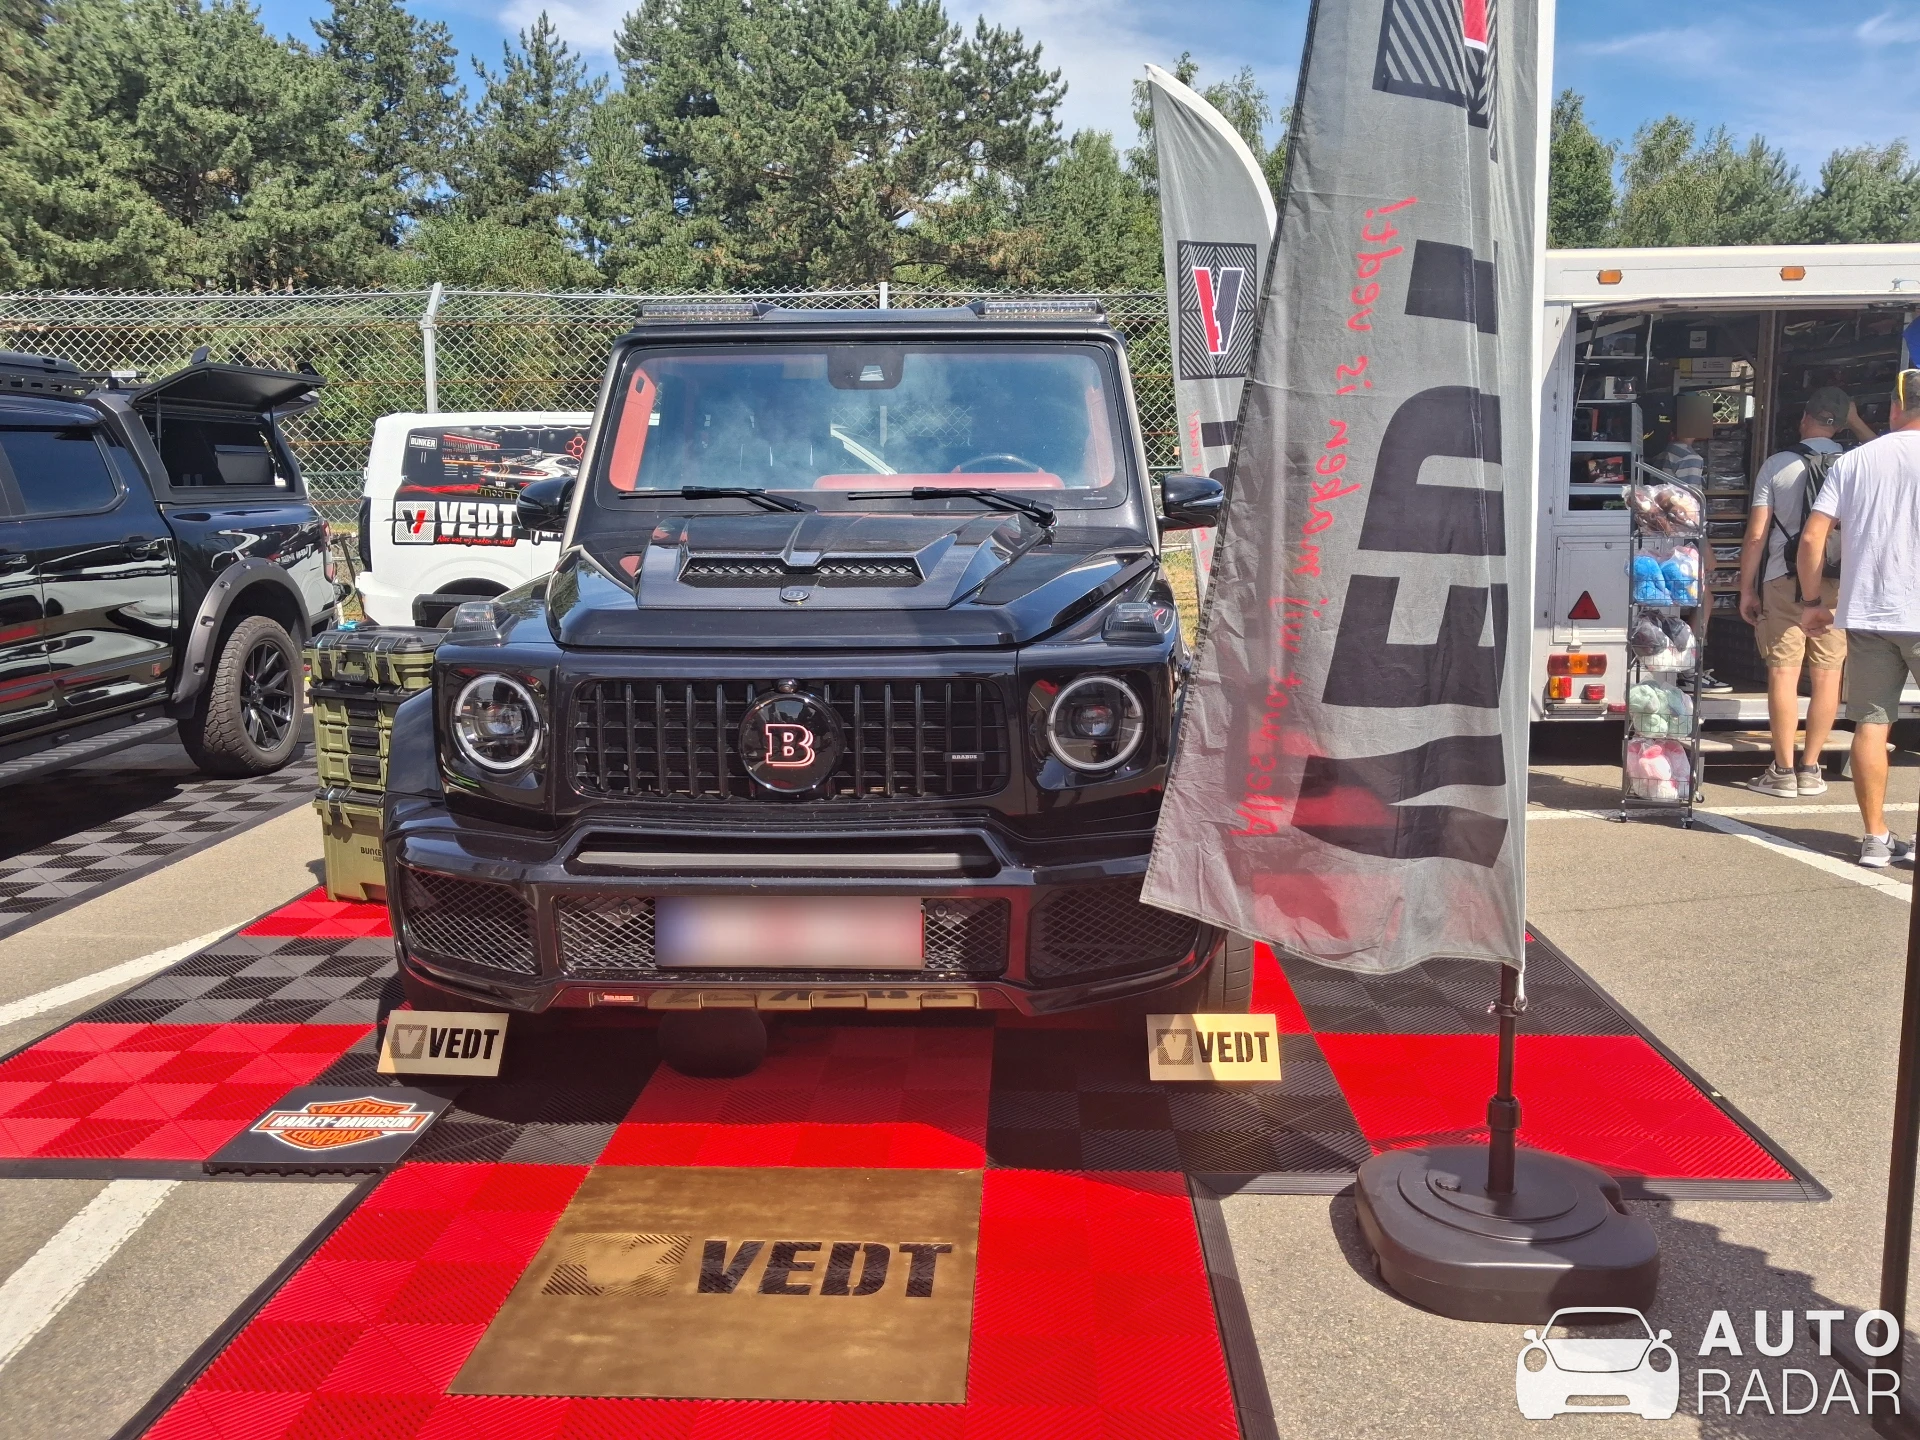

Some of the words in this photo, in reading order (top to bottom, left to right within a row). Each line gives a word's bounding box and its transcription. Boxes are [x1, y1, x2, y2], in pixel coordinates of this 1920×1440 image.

[410, 437, 436, 448] BUNKER
[438, 501, 518, 538] VEDT
[766, 724, 815, 767] B
[360, 846, 383, 857] BUNKE
[429, 1027, 500, 1060] VEDT
[1196, 1031, 1270, 1063] VEDT
[271, 1115, 415, 1129] HARLEY-DAVIDSON
[292, 1130, 370, 1146] COMPANY
[697, 1240, 953, 1298] VEDT
